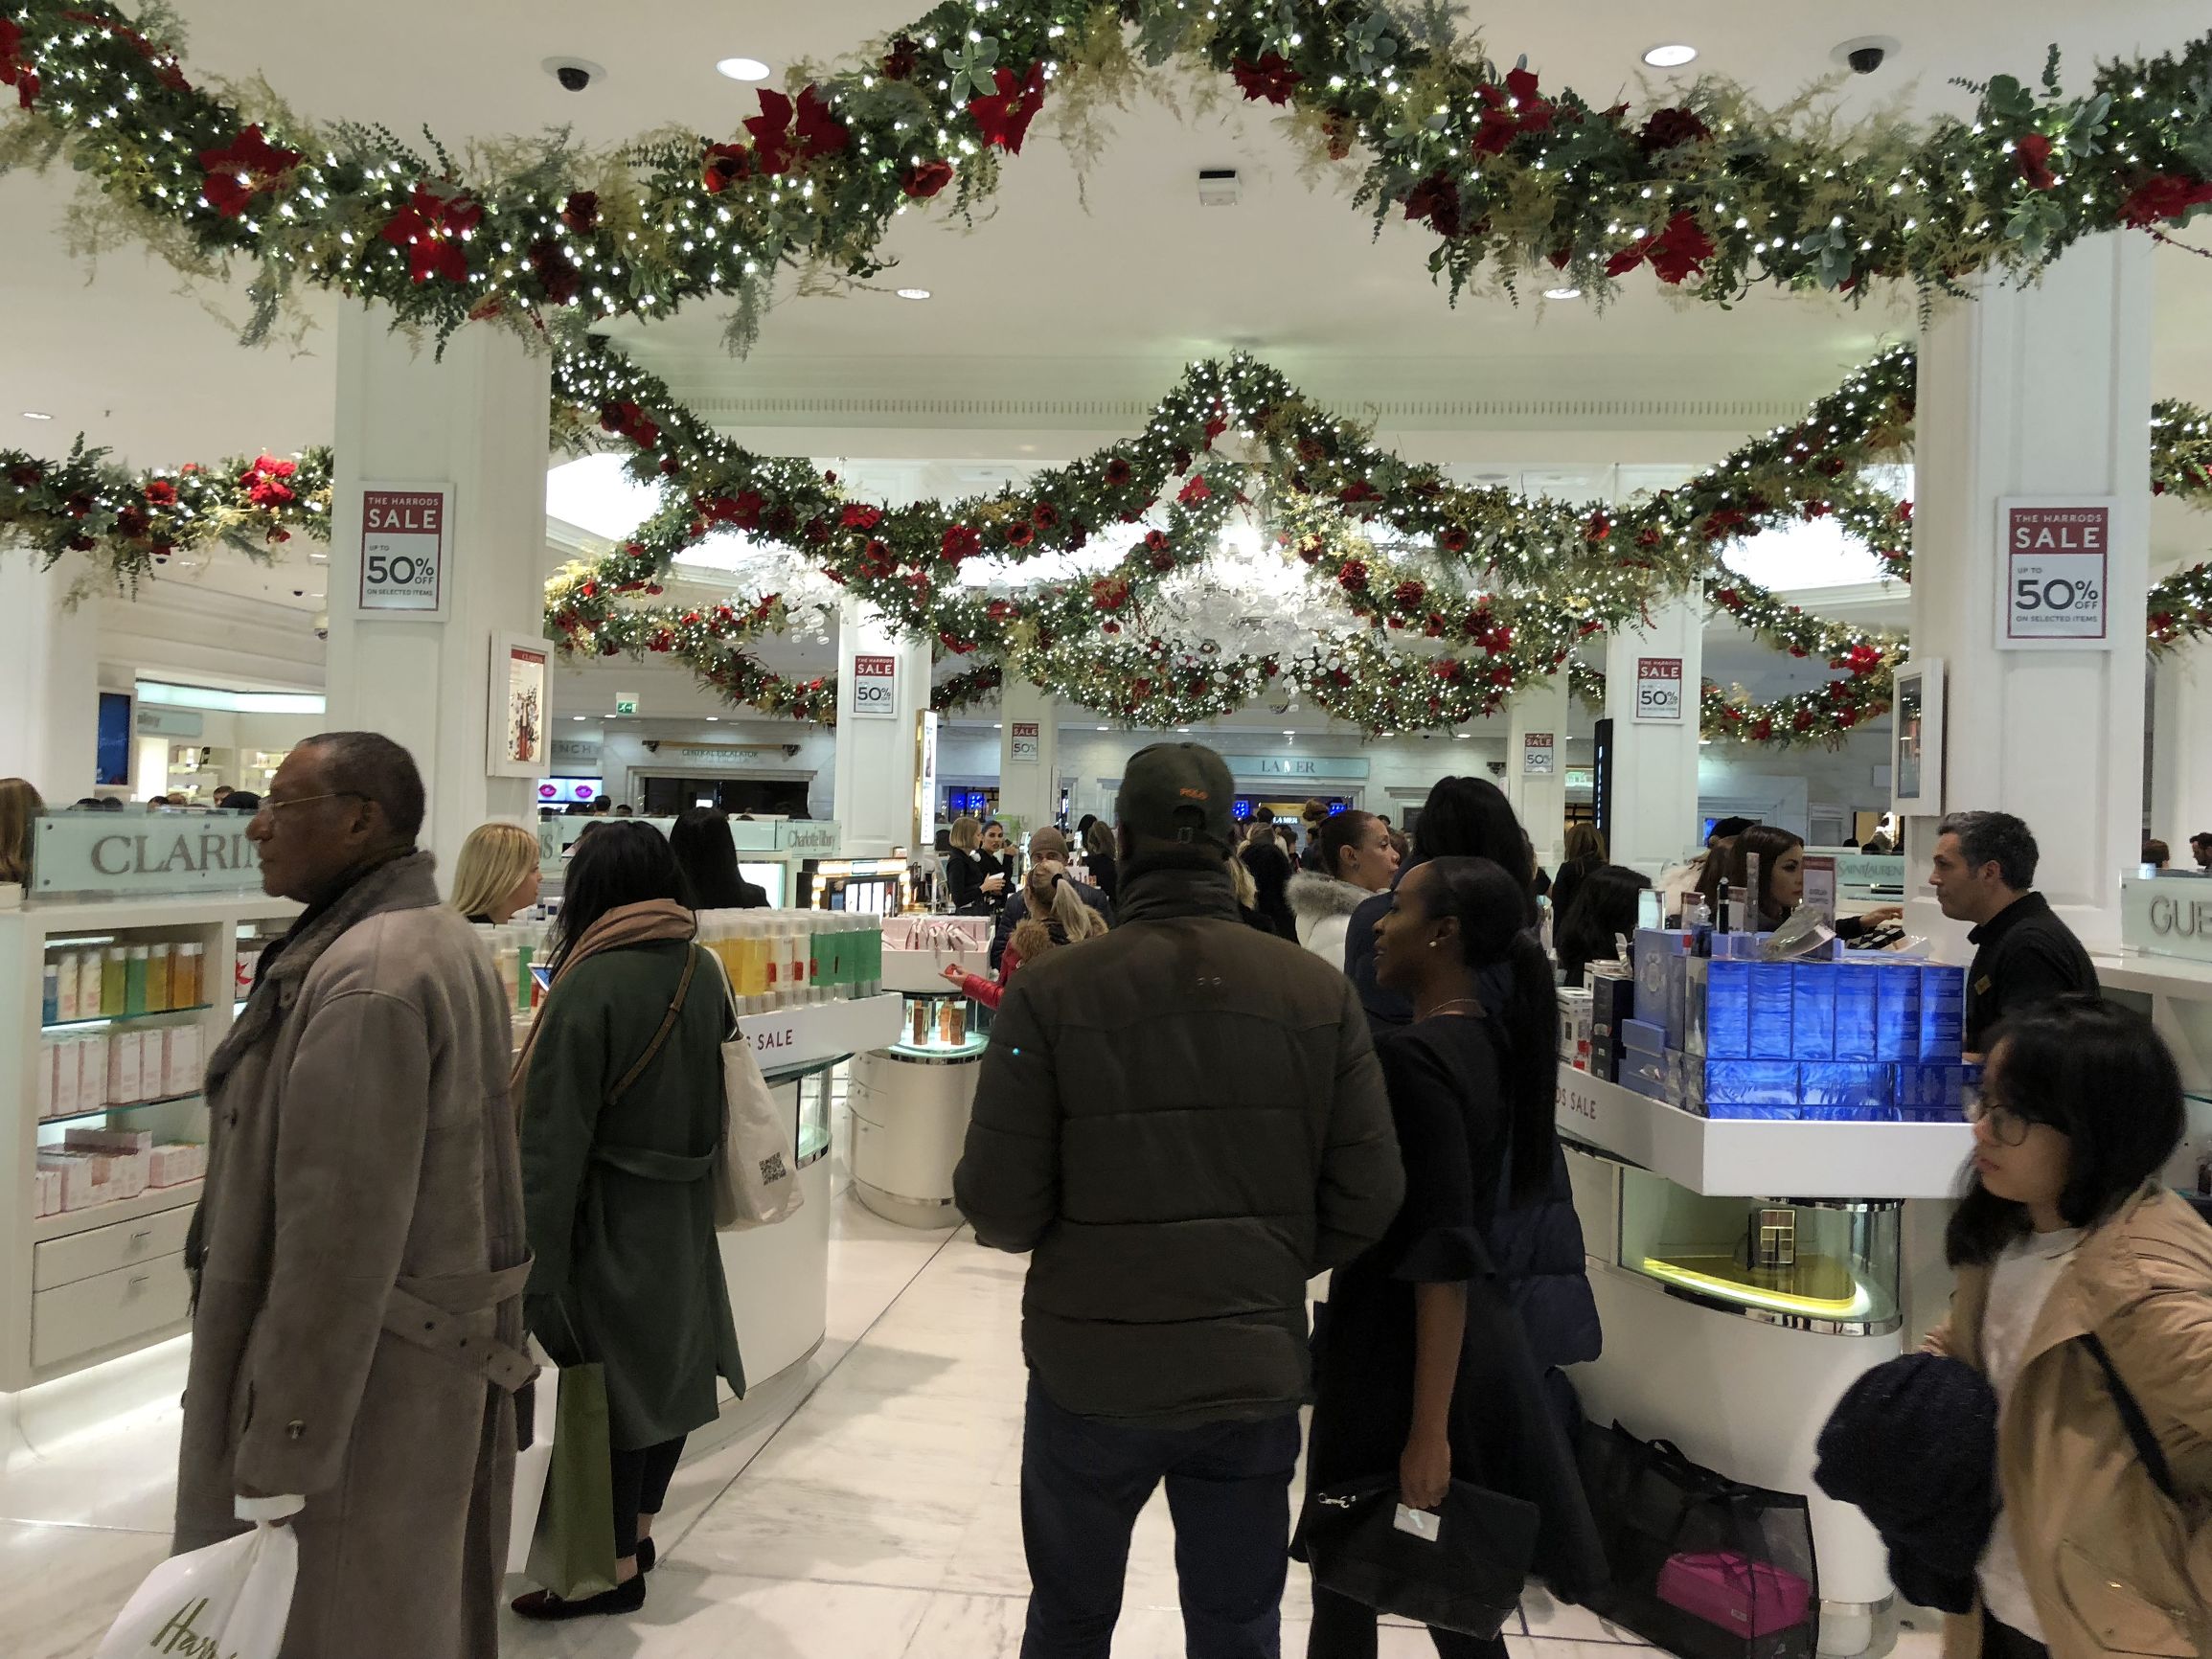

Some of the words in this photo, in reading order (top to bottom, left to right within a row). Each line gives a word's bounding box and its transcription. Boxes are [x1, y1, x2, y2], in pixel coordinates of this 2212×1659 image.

[368, 497, 387, 506] THE
[369, 509, 436, 529] SALE
[2015, 514, 2039, 523] THE
[2043, 514, 2102, 523] HARRODS
[2015, 527, 2100, 549] SALE
[367, 556, 434, 584] 50%
[2016, 579, 2098, 610] 50%
[2075, 601, 2098, 609] OFF
[857, 664, 892, 674] SALE
[1641, 667, 1678, 677] SALE
[857, 687, 891, 700] 50%
[1640, 691, 1677, 705] 50%
[1262, 760, 1280, 773] LA
[758, 1029, 793, 1050] SALE
[1571, 1092, 1596, 1120] SALE
